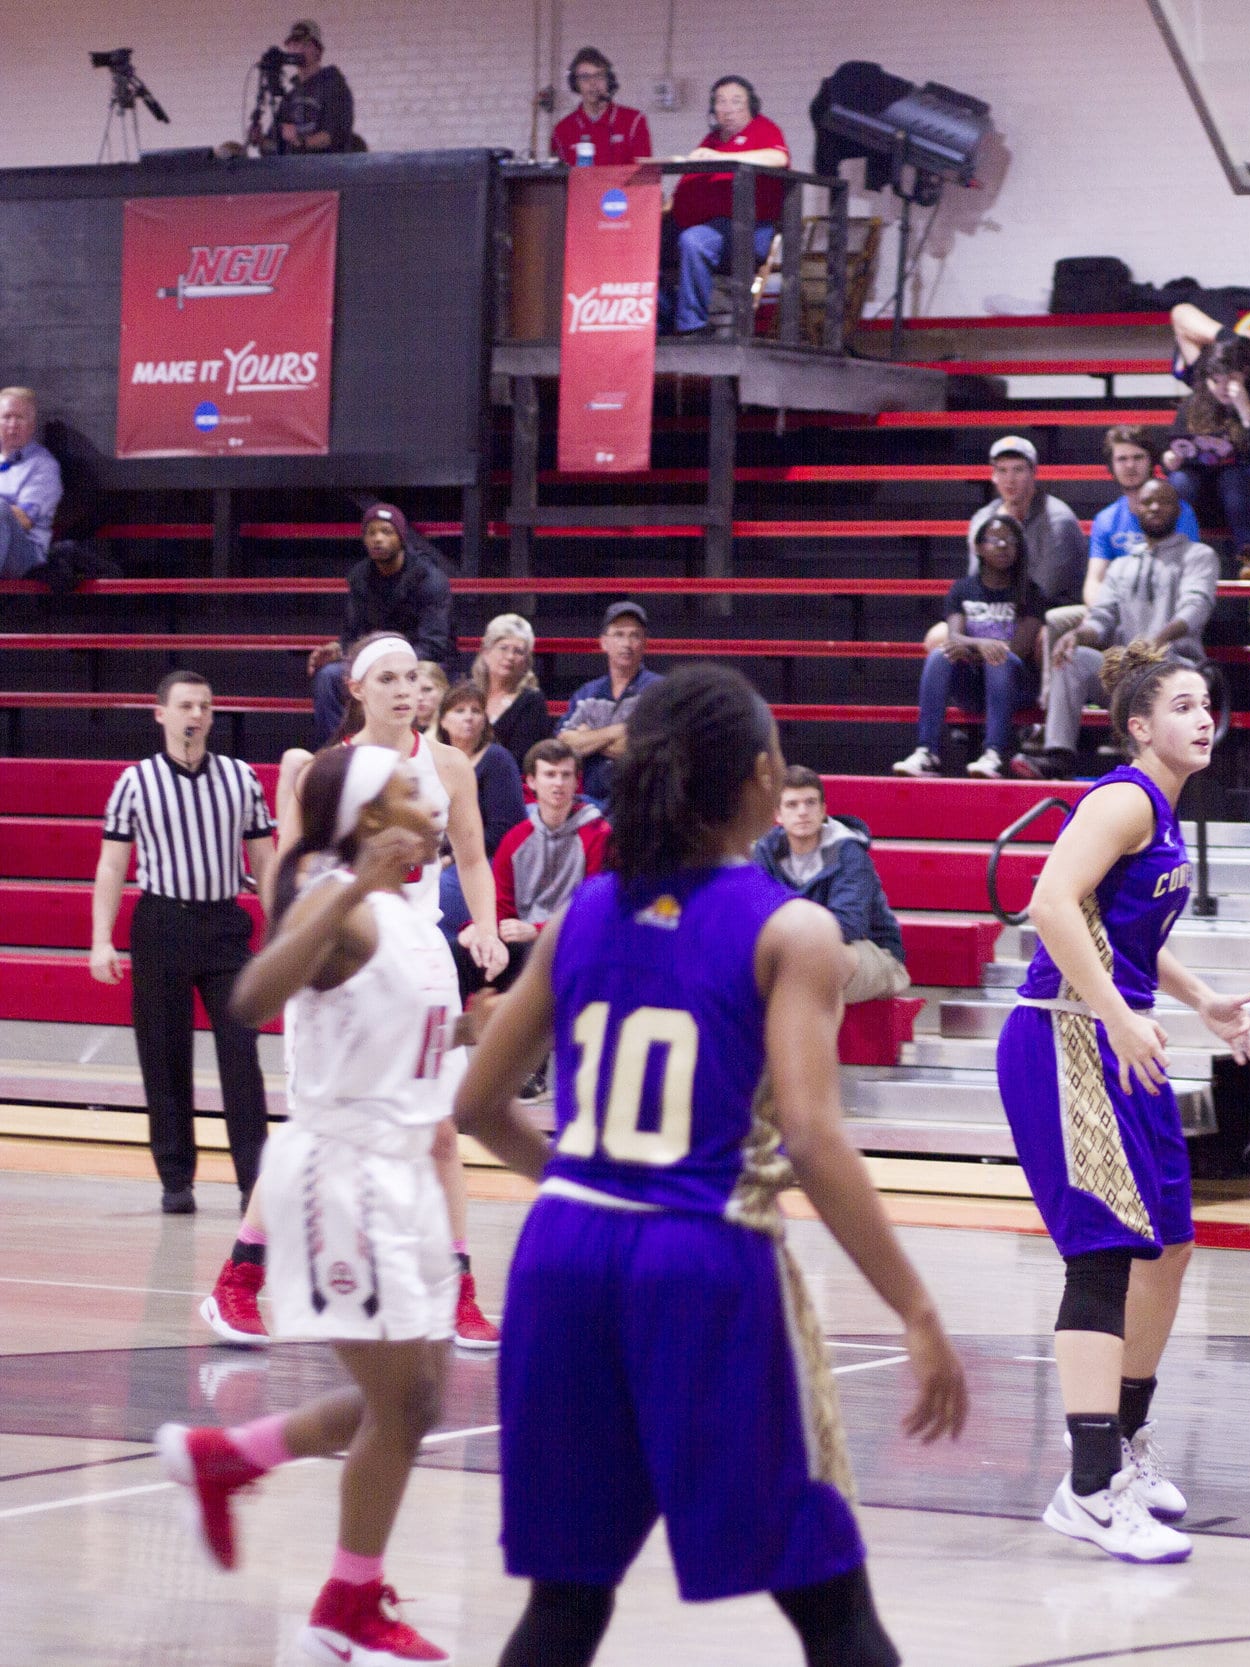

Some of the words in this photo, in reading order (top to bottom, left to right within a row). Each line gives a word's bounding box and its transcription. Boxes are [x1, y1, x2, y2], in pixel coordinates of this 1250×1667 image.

[186, 244, 290, 285] NGU
[567, 287, 653, 334] YOURS
[132, 361, 196, 384] MAKE
[200, 361, 224, 382] IT
[223, 341, 318, 395] YOURS
[557, 1001, 698, 1166] 10
